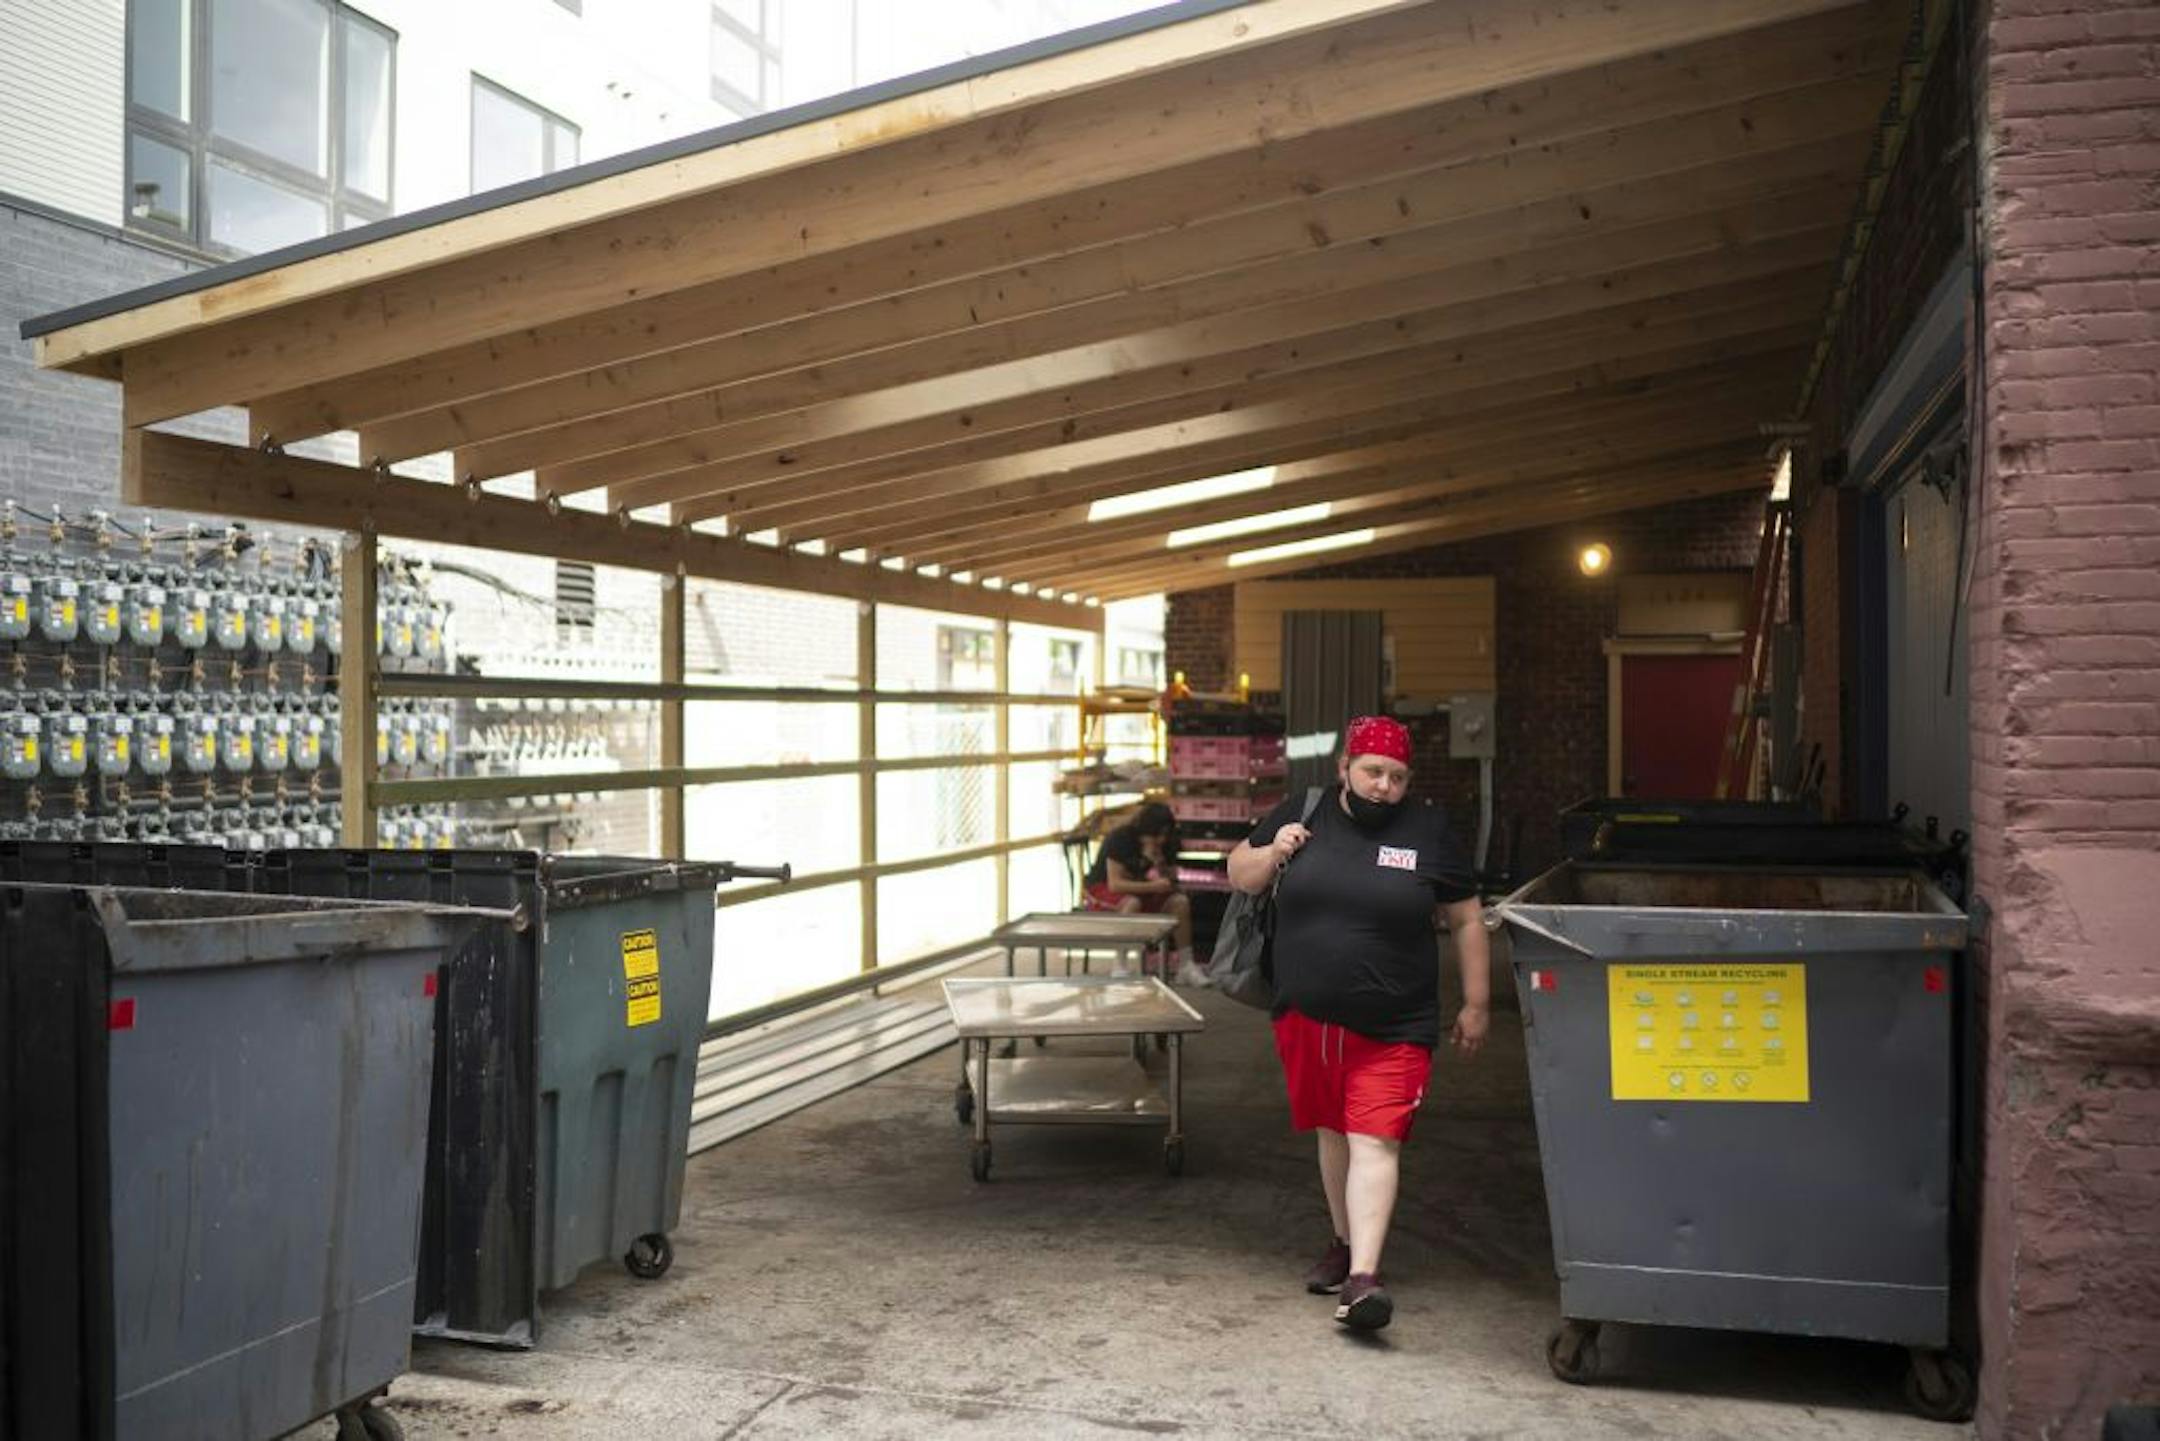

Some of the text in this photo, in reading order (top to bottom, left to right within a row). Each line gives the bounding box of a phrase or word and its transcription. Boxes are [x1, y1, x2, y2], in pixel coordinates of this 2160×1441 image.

[623, 934, 655, 951] CAUTION
[1626, 970, 1788, 979] SINGLE STREAM RECYCLING
[628, 980, 659, 996] CAUTION
